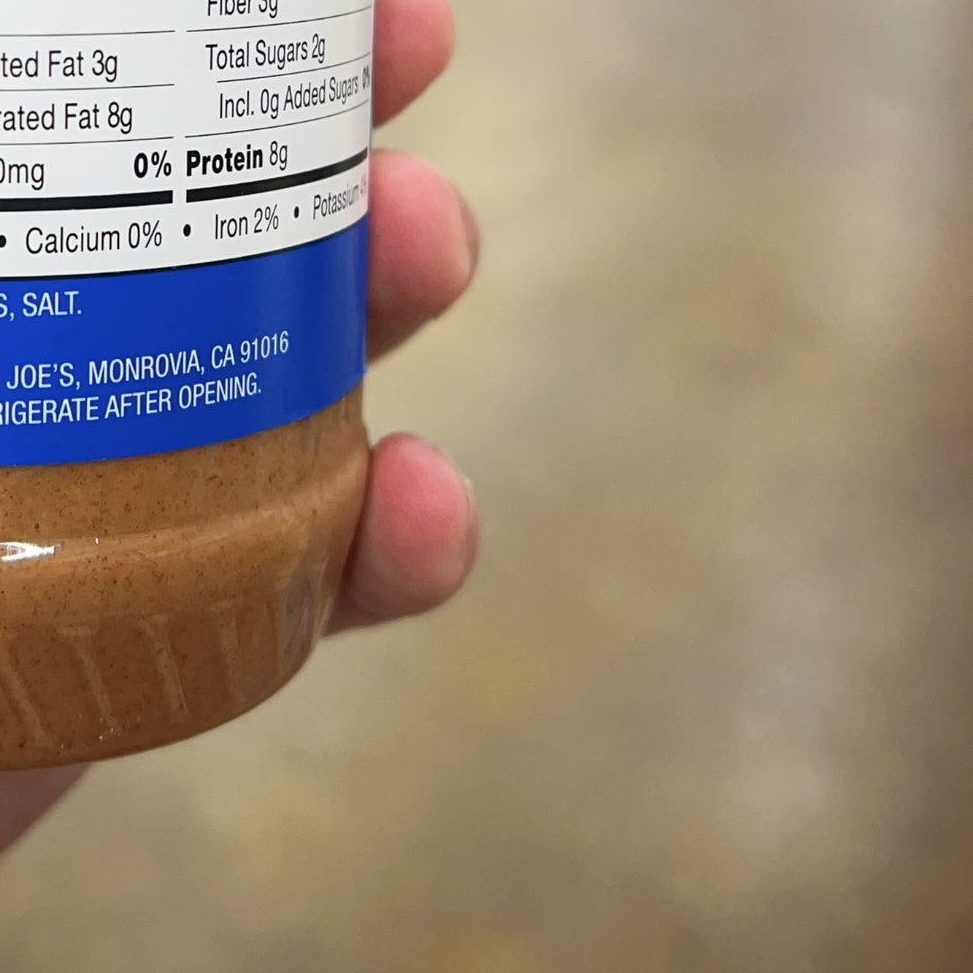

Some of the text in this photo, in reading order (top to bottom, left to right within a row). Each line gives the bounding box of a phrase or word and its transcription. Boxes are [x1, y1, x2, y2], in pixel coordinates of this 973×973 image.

[48, 50, 84, 77] Fat
[92, 50, 118, 82] 3g
[206, 33, 325, 71] Total Sugars 2g
[220, 89, 254, 119] Incl.
[260, 88, 279, 118] 0g
[284, 80, 326, 111] Added
[329, 75, 359, 105] Sugars
[65, 103, 100, 130] Fat
[108, 101, 133, 134] 8g
[133, 150, 172, 179] 0%
[186, 140, 288, 177] Protein 8g
[26, 225, 121, 254] Calcium
[129, 220, 163, 249] 0%
[215, 212, 248, 240] Iron
[254, 204, 279, 234] 2%
[313, 183, 359, 220] Potassium
[22, 290, 82, 318] SALT.
[88, 349, 205, 385] MONROVIA,
[211, 343, 235, 369] CA
[240, 330, 289, 364] 91016
[105, 388, 171, 419] AFTER
[178, 372, 261, 409] OPENING.
